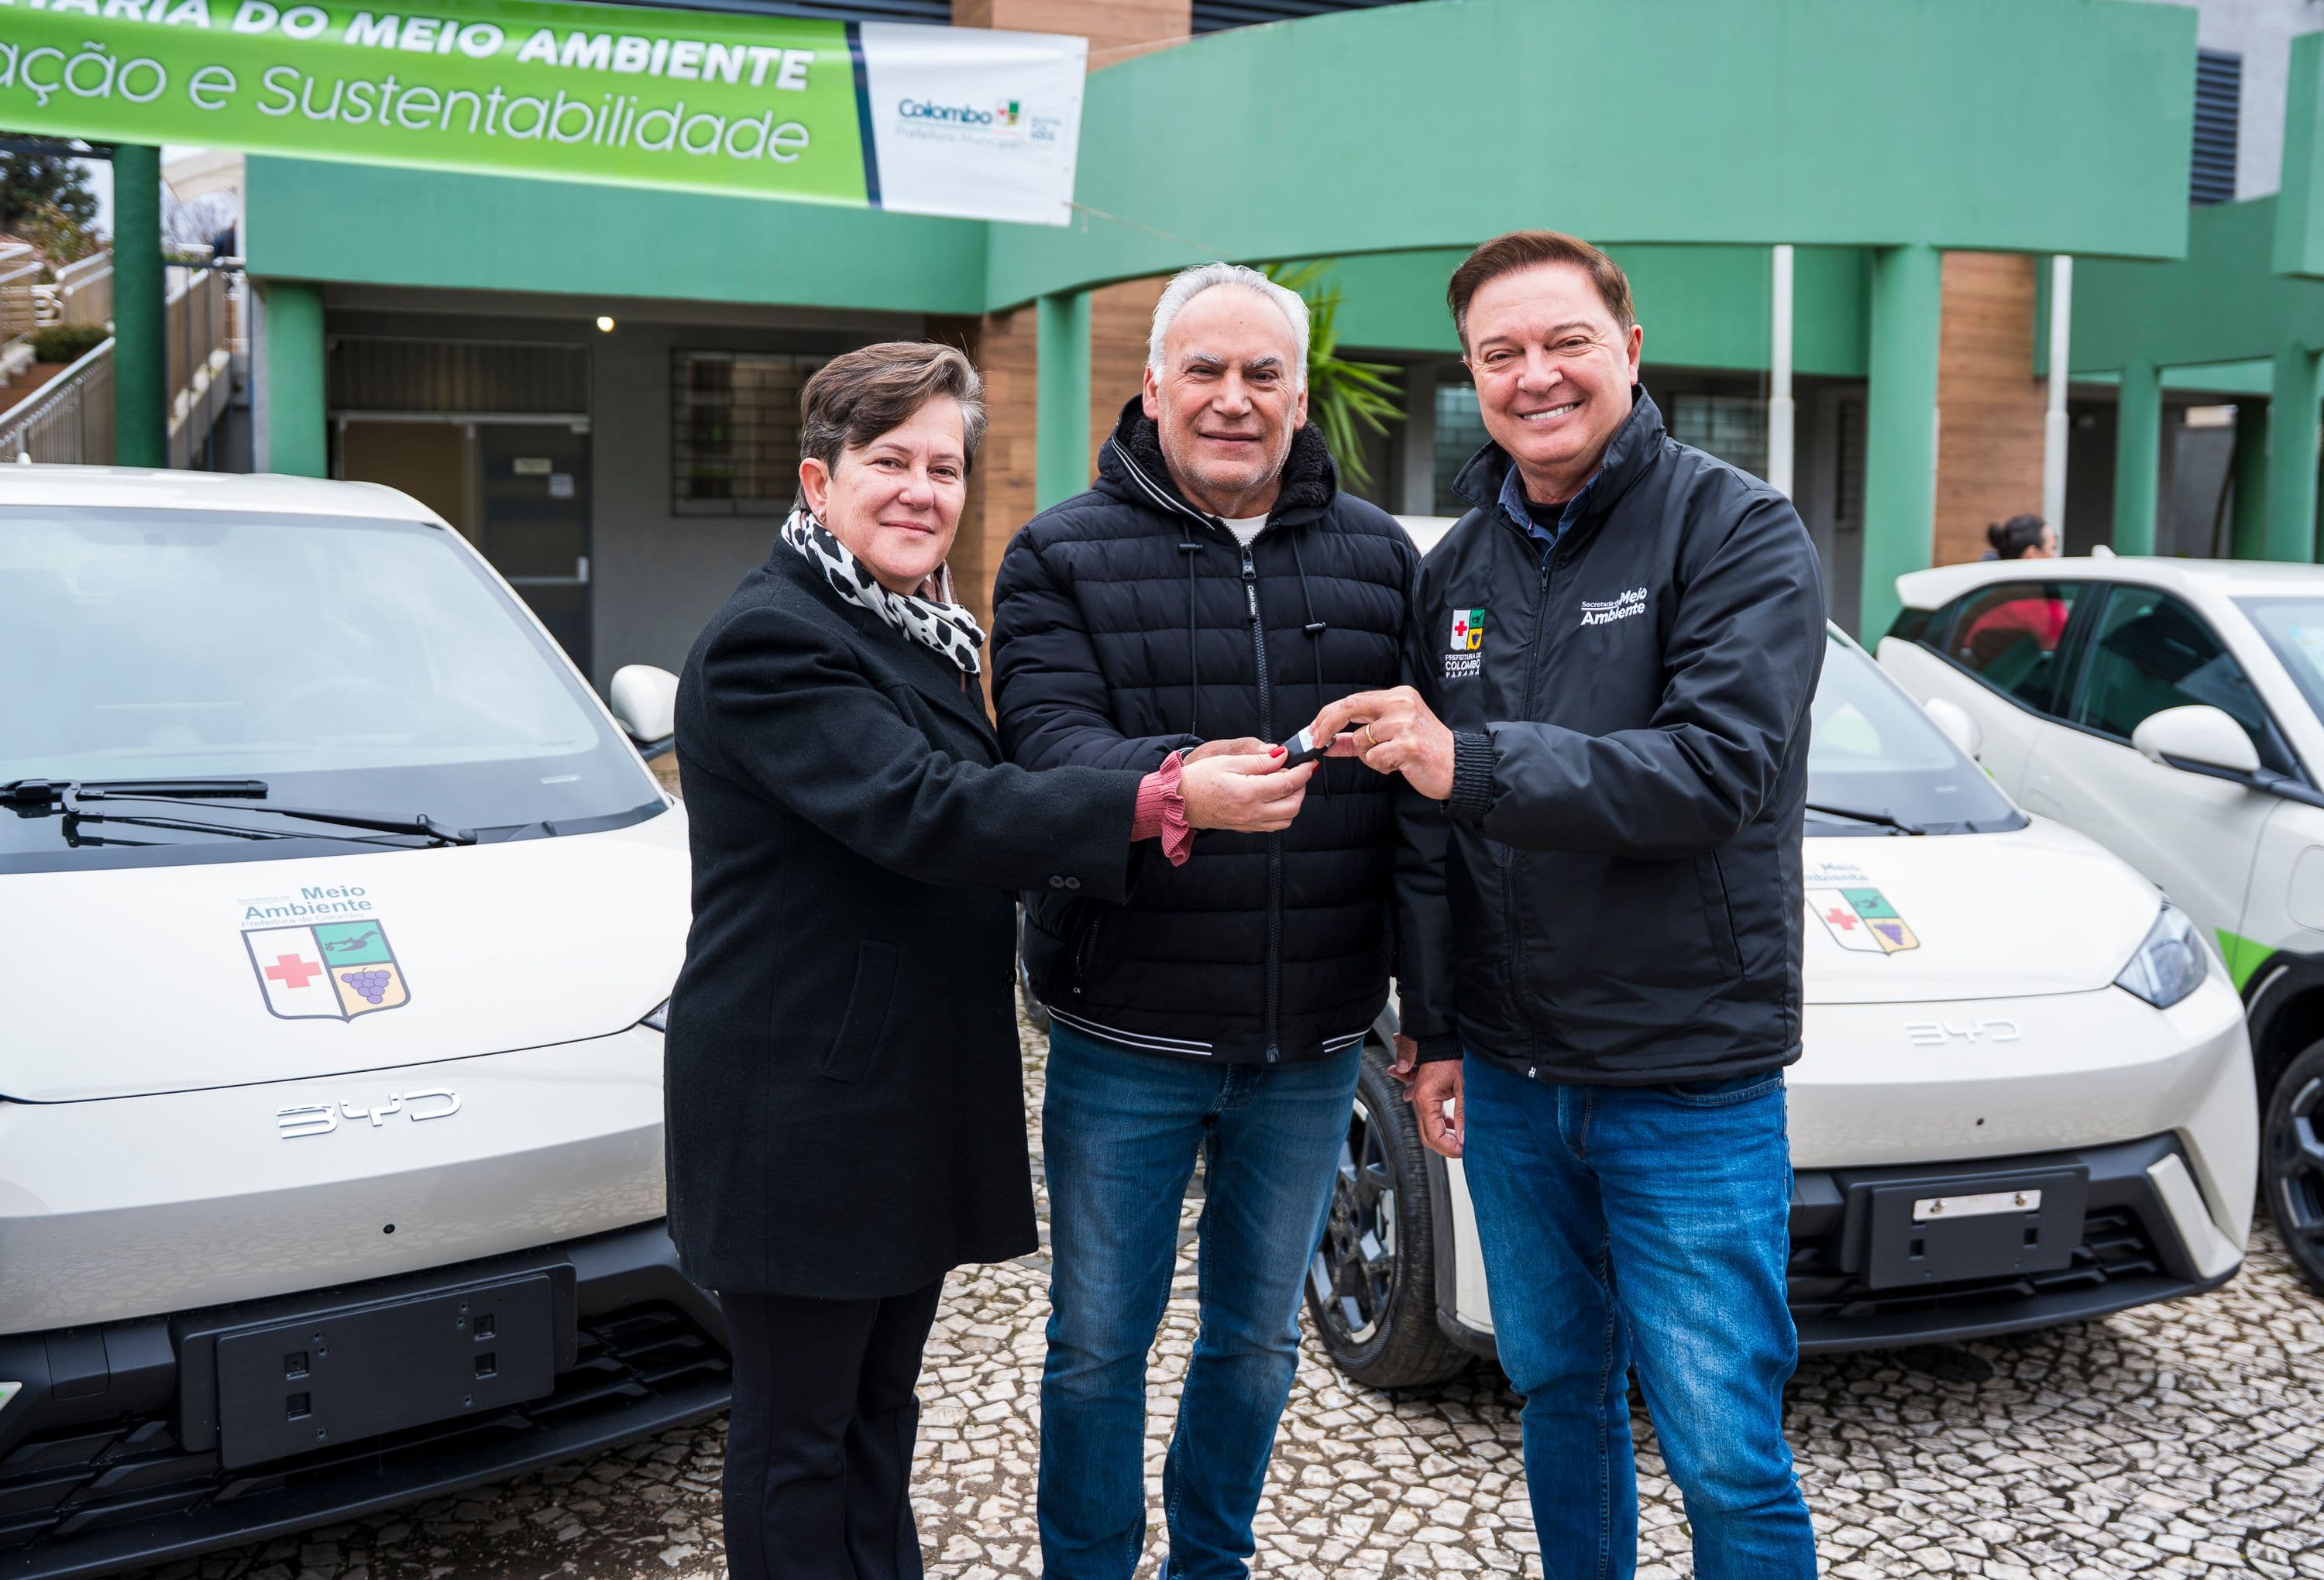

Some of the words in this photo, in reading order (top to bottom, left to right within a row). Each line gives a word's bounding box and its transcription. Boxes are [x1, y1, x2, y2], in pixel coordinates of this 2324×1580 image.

[232, 0, 330, 40] DO
[343, 12, 505, 58] MEIO
[517, 27, 815, 91] AMBIENTE
[188, 65, 237, 111] e
[256, 66, 810, 164] Sustentabilidade
[898, 98, 993, 125] Colombo
[1619, 587, 1647, 605] Meio
[1580, 602, 1645, 625] Ambiente
[1446, 658, 1480, 670] COLOMBO
[301, 885, 366, 901] Meio
[244, 898, 373, 921] Ambiente
[1903, 1016, 2023, 1046] BYD
[276, 1087, 462, 1139] BYD
